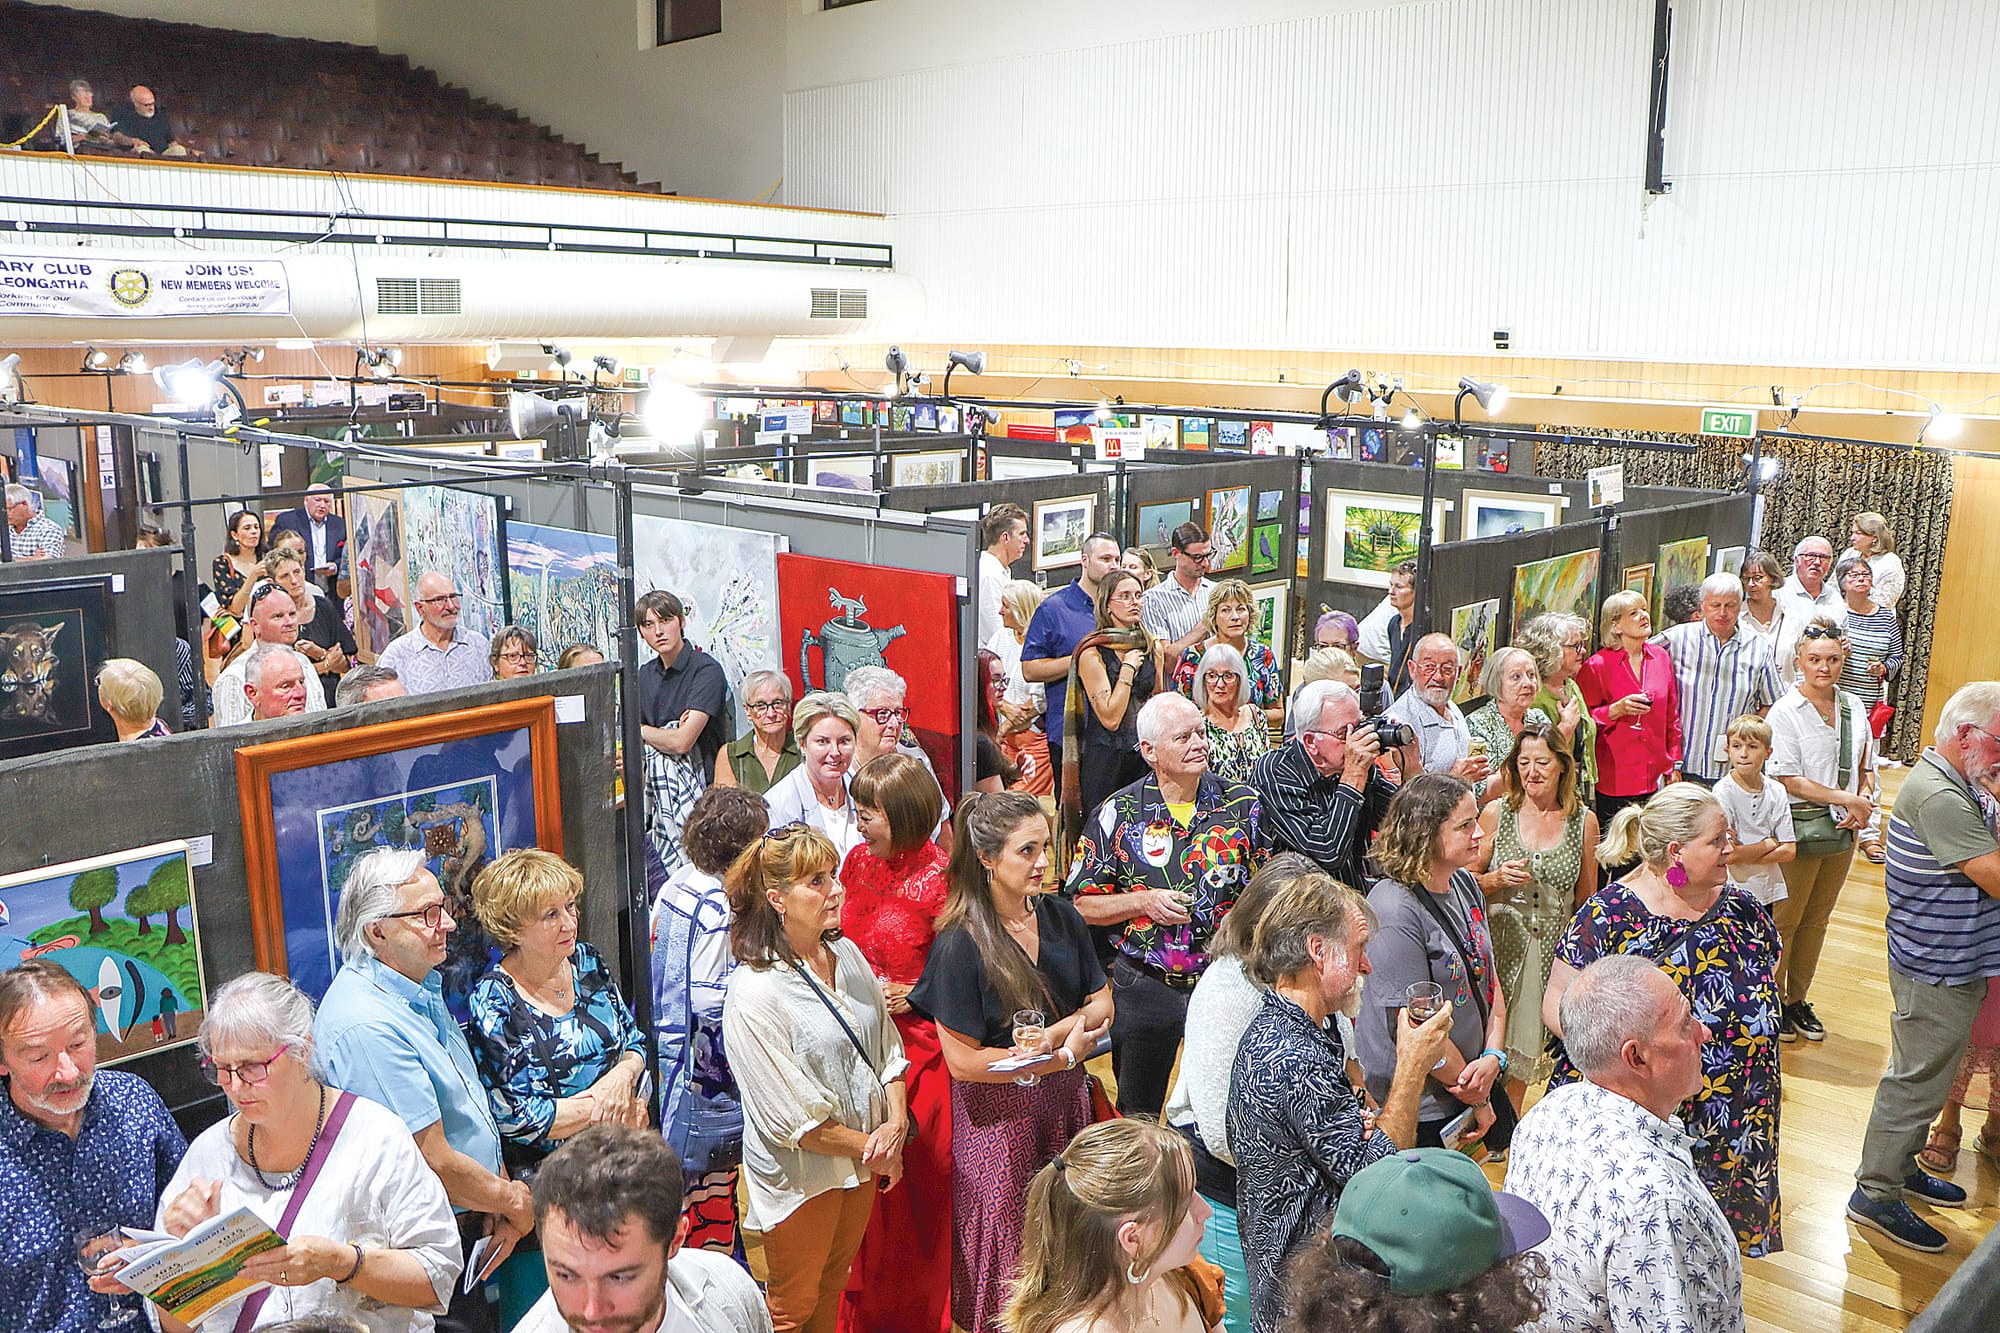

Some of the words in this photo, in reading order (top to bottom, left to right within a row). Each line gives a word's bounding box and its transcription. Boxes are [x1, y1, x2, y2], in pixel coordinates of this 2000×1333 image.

[44, 263, 92, 275] CLUB
[185, 264, 222, 276] JOIN
[227, 265, 254, 276] US!
[161, 280, 183, 290] NEW
[186, 280, 232, 290] MEMBERS
[235, 279, 280, 289] WELCOME
[0, 292, 33, 300] orking
[1710, 414, 1743, 433] EXIT
